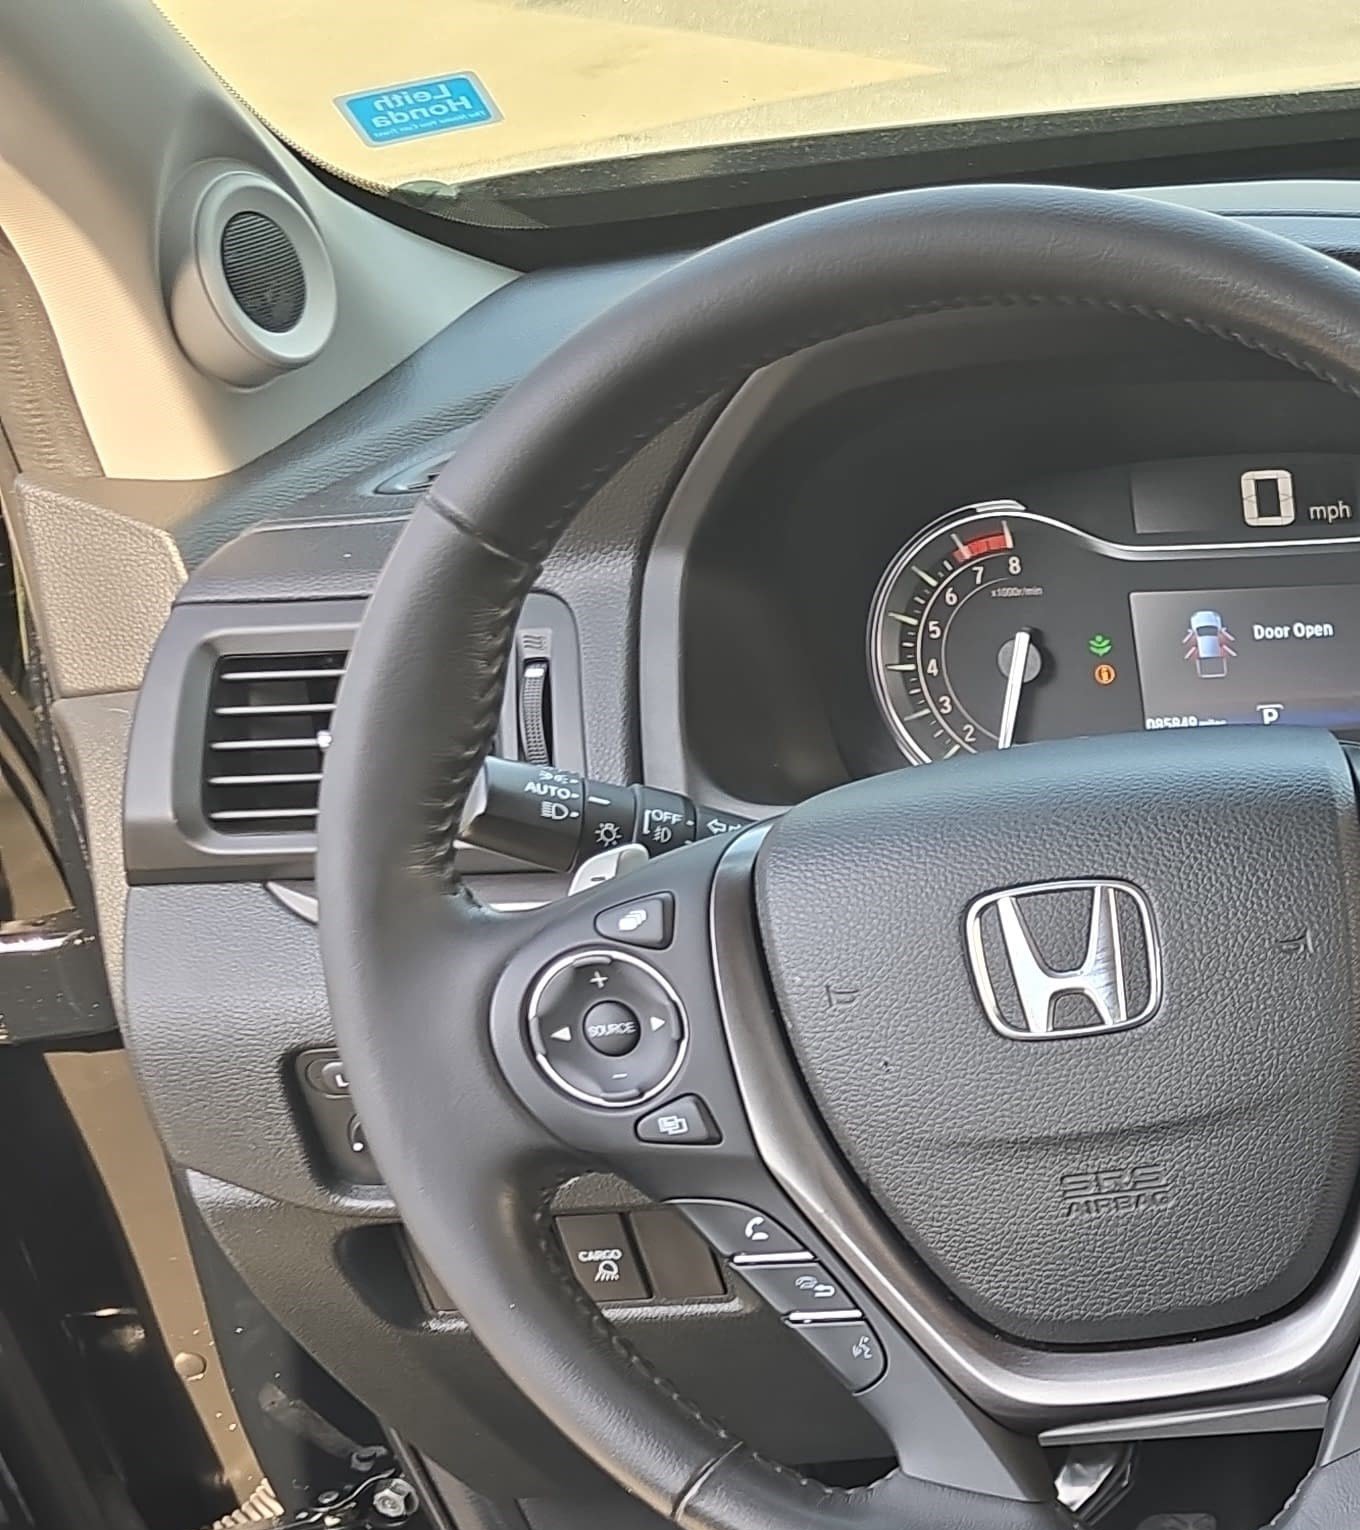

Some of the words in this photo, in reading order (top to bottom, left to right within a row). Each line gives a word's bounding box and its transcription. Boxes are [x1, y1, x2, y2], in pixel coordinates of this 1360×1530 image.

[1240, 469, 1296, 527] 0
[1309, 501, 1352, 524] mph
[1009, 556, 1021, 575] 8
[972, 566, 985, 584] 7
[944, 588, 958, 605] 6
[928, 621, 941, 639] 5
[1253, 623, 1290, 640] Door
[1293, 622, 1334, 640] Open
[927, 658, 939, 677] 4
[939, 696, 953, 713] 3
[962, 725, 976, 742] 2
[525, 781, 571, 800] AUTO
[651, 810, 683, 825] OFF
[587, 1020, 637, 1038] SOURCE
[578, 1249, 623, 1262] CARGO
